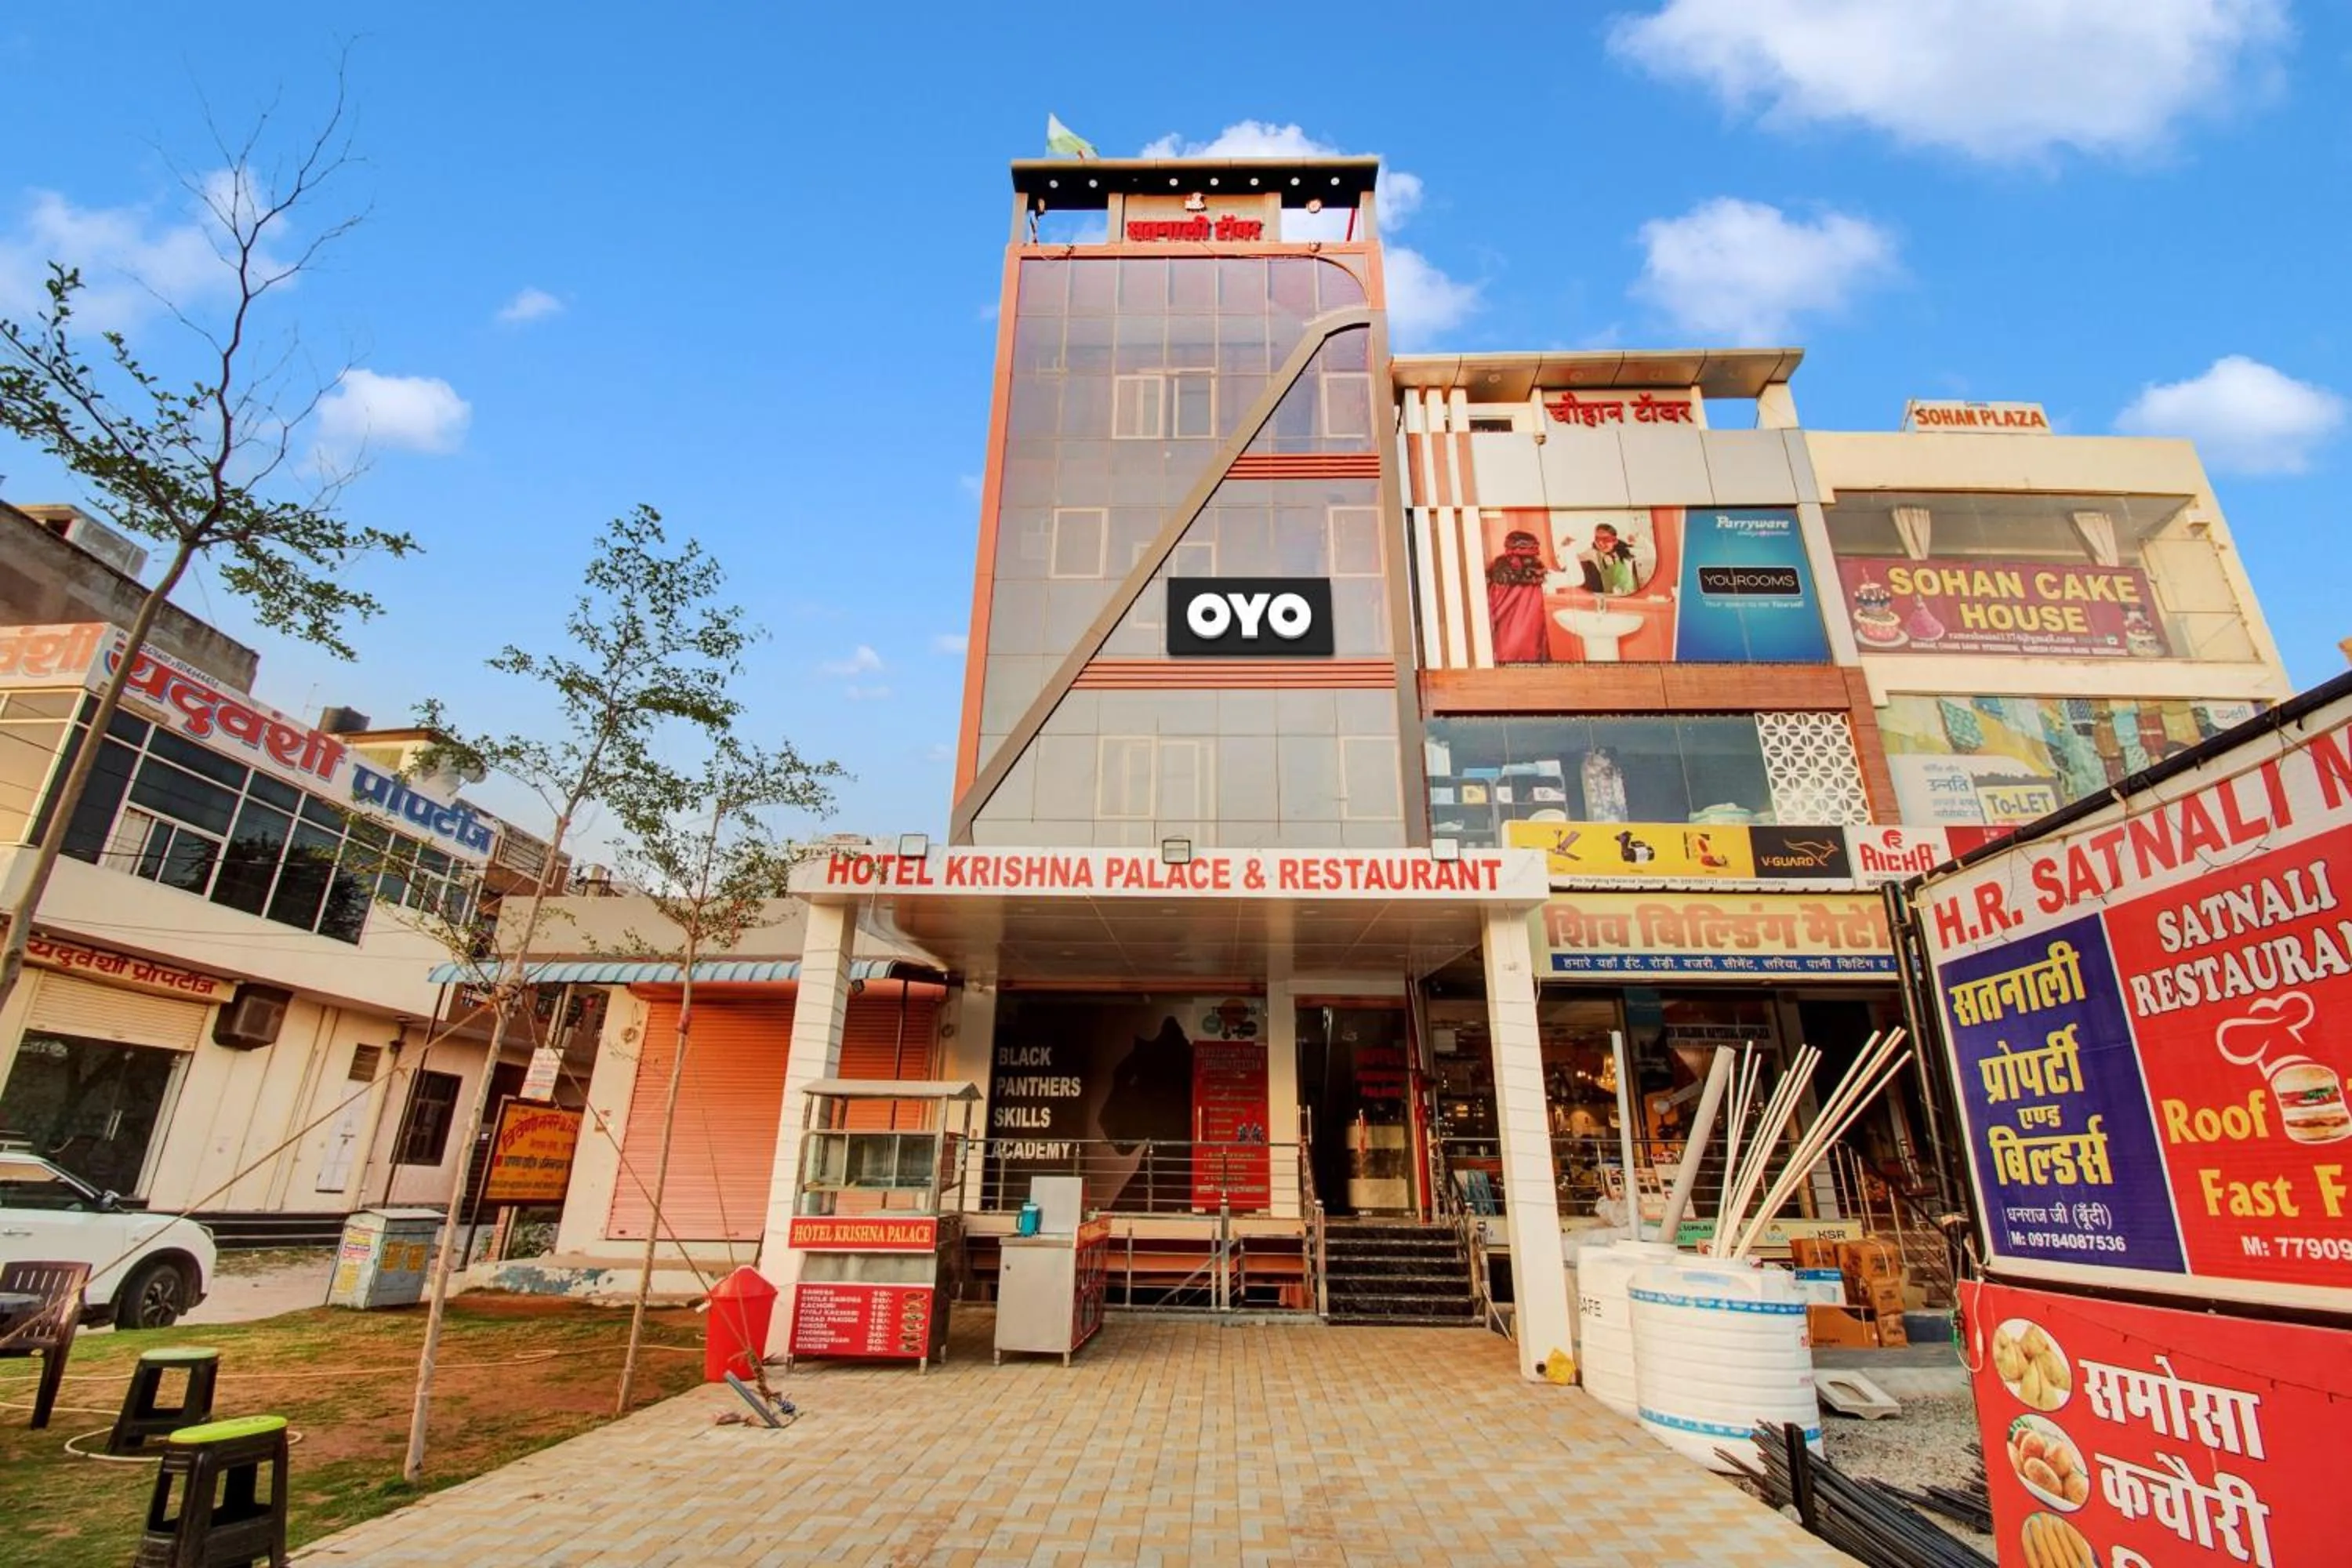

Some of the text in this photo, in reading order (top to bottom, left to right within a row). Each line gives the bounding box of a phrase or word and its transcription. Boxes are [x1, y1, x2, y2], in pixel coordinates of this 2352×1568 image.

[1544, 392, 1693, 427] चौहान टॉवर
[1915, 408, 2048, 427] SOHAN PLAZA
[1715, 515, 1789, 531] Parryware
[1704, 574, 1795, 587] YOUROOMS
[1887, 567, 2142, 603] SOHAN CAKE
[1187, 593, 1312, 639] OYO
[1960, 603, 2089, 633] HOUSE
[1761, 857, 1815, 866] V-GUARD
[1934, 882, 2024, 949] H.R.
[2031, 758, 2293, 915] SATNALI
[827, 853, 1502, 890] HOTEL KRISHNA PALACE & RESTAURANT
[2157, 860, 2339, 954] SATNALI
[1541, 903, 1631, 948] शिव
[1949, 941, 2086, 1027] सतनाली
[998, 1047, 1052, 1066] BLACK
[1979, 1023, 2084, 1105] प्रोपर्टी
[996, 1076, 1082, 1097] PANTHERS
[993, 1107, 1051, 1127] SKILLS
[2016, 1105, 2062, 1129] एण्ड
[2161, 1089, 2270, 1144] Roof
[991, 1142, 1072, 1160] ACADEMY
[1987, 1114, 2114, 1185] बिल्डर्स
[2198, 1169, 2299, 1217] Fast
[2007, 1207, 2048, 1224] धनराज
[2050, 1202, 2069, 1224] जी
[794, 1225, 931, 1243] HOTEL KRISHNA PALACE
[2011, 1231, 2127, 1252] M: 09784087536
[2241, 1236, 2270, 1256] M:
[2078, 1355, 2267, 1461] समोसा
[2094, 1451, 2274, 1568] कचौरी
